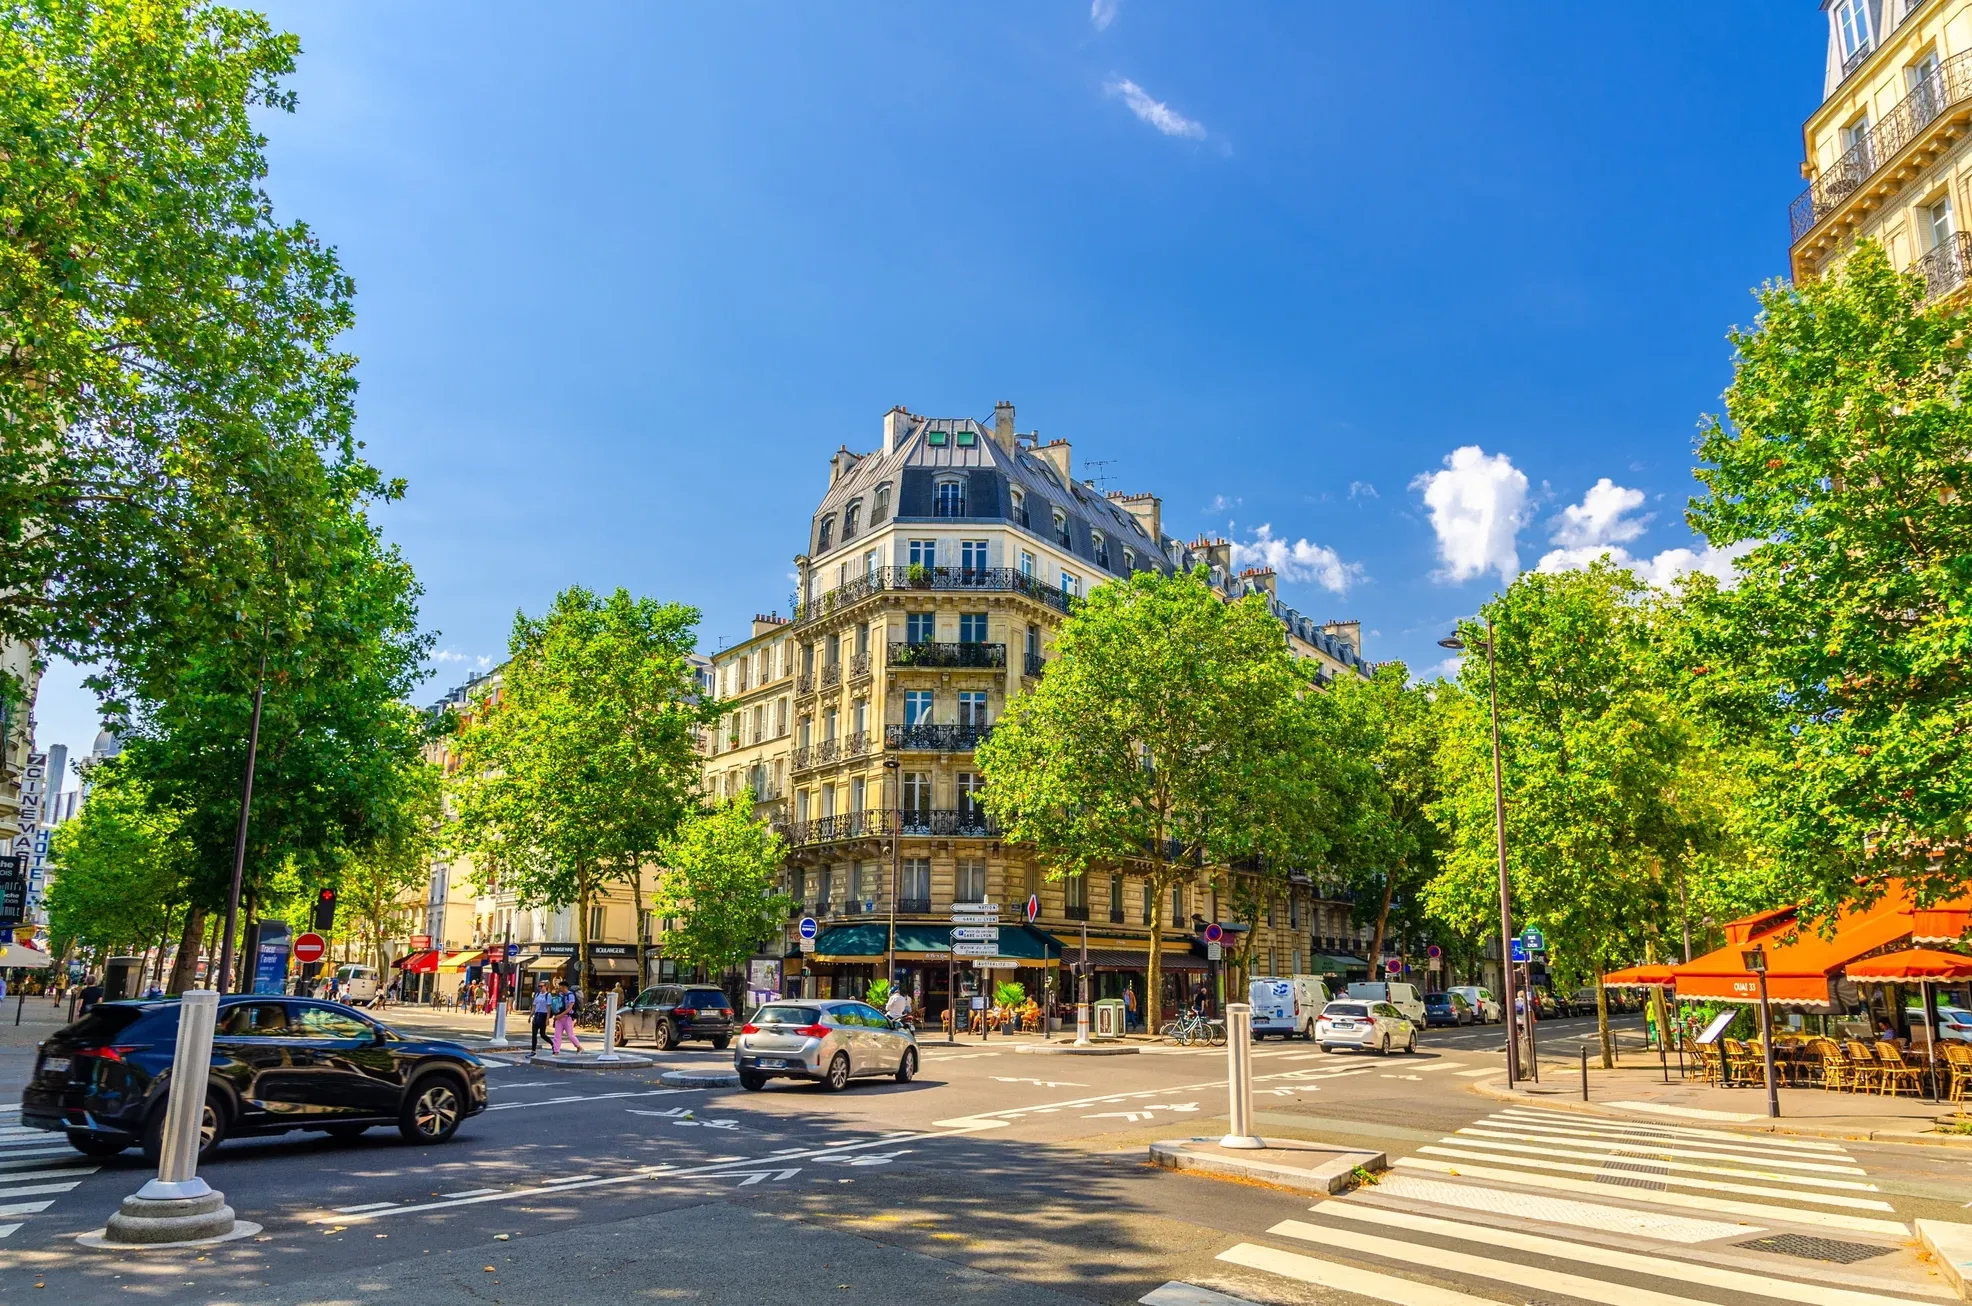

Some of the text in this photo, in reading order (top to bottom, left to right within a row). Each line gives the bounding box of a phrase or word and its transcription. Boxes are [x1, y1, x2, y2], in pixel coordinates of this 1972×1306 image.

[30, 754, 44, 764] 7
[28, 829, 49, 893] HOTEL
[1733, 982, 1756, 992] QUAI 33
